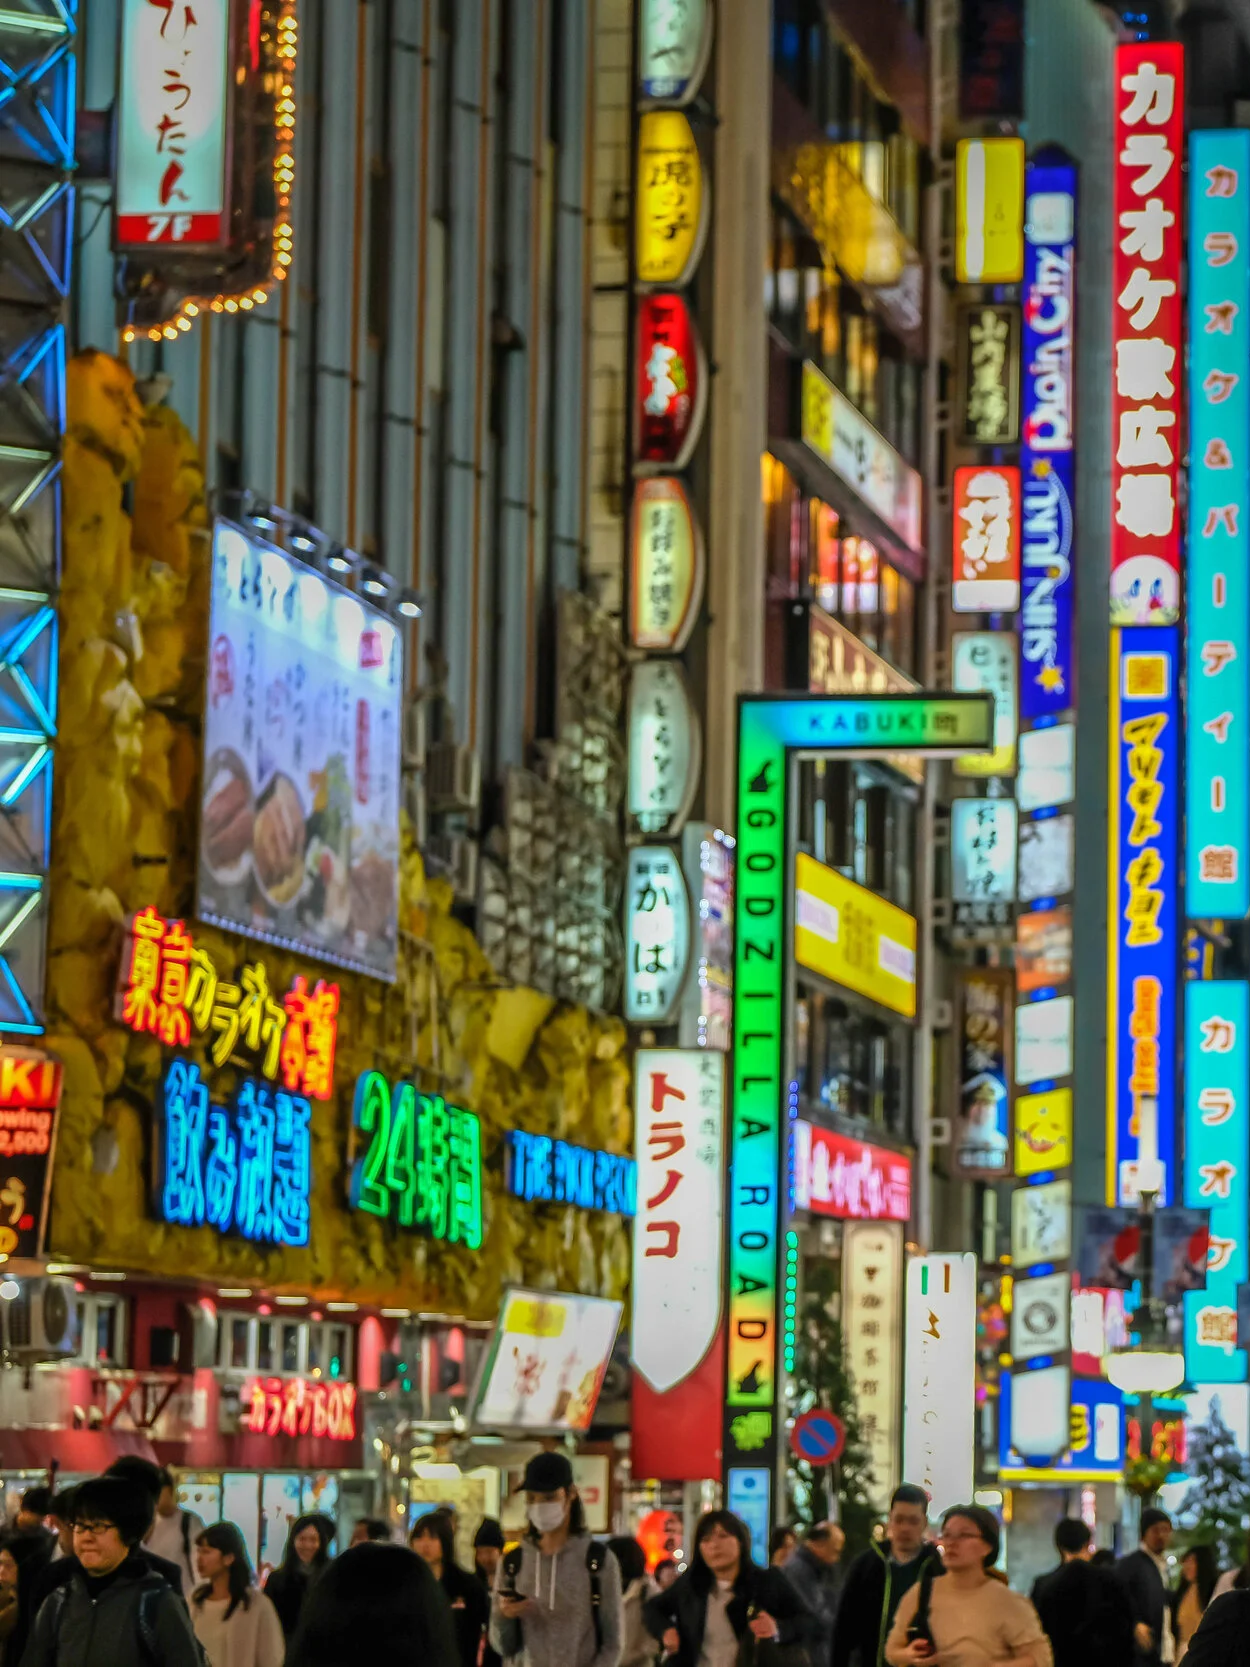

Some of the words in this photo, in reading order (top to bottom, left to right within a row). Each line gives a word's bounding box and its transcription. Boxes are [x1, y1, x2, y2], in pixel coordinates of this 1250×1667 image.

[145, 214, 193, 241] 7F
[634, 886, 671, 974] かは
[740, 807, 776, 1142] GODZILLA
[354, 1070, 483, 1250] 24時間
[645, 1072, 686, 1259] トラノコ
[737, 1184, 770, 1341] ROAD
